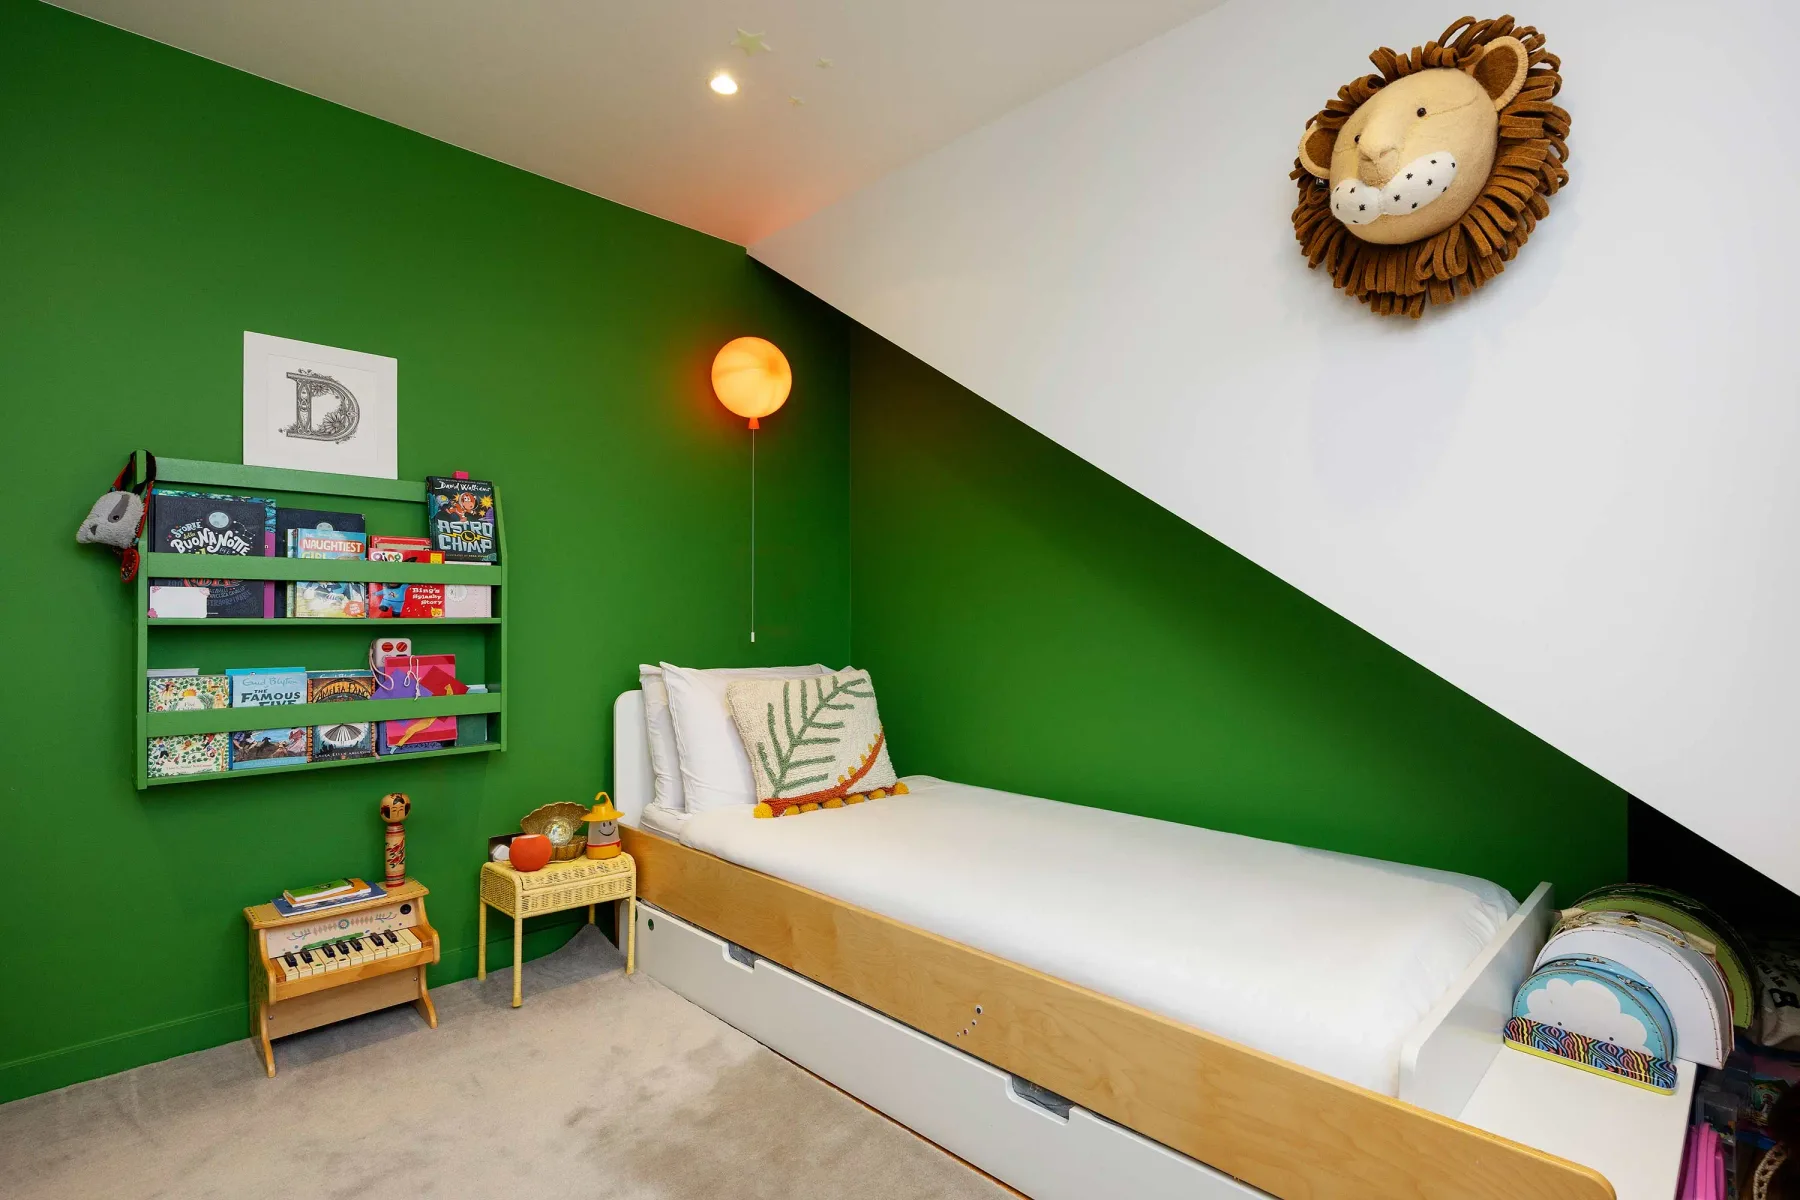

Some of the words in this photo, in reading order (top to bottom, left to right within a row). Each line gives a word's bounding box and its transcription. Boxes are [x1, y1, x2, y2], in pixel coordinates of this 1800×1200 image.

[281, 369, 360, 443] D
[435, 480, 460, 491] David
[437, 519, 493, 538] ASTRO
[302, 539, 362, 553] NAUGHTIEST
[437, 534, 492, 553] CHIMP
[241, 691, 301, 703] FAMOUS
